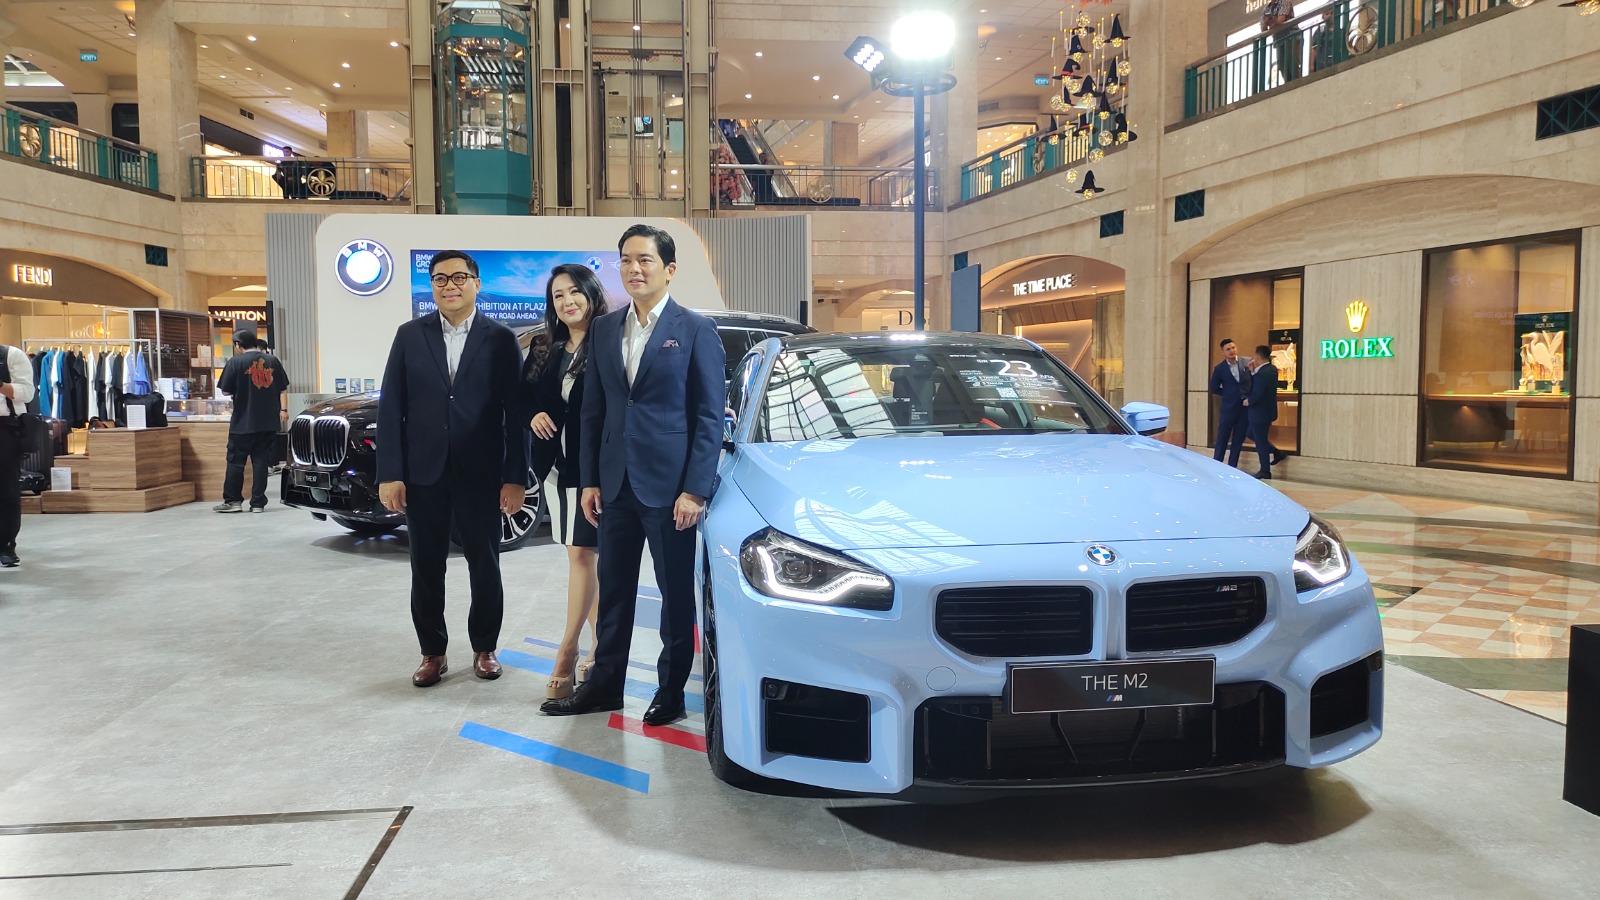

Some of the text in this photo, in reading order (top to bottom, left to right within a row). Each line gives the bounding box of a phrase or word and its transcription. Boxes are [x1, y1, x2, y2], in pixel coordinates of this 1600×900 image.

[14, 264, 52, 286] FENDI
[1013, 274, 1072, 296] THE TIME PLACE
[512, 302, 523, 310] AT
[1320, 336, 1393, 359] ROLEX
[1080, 672, 1149, 691] THE M2
